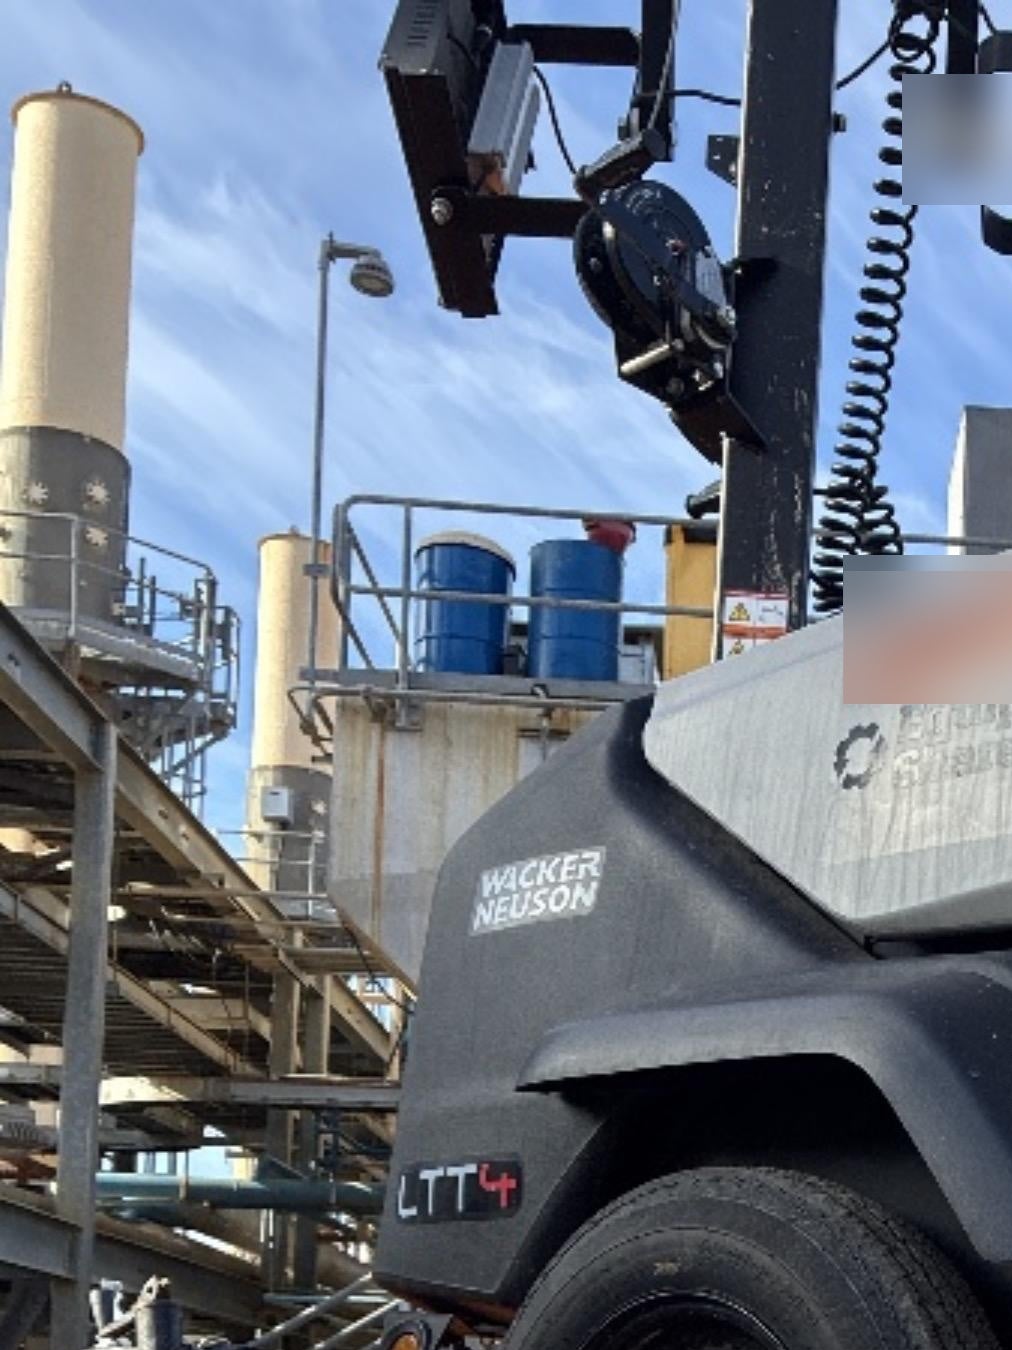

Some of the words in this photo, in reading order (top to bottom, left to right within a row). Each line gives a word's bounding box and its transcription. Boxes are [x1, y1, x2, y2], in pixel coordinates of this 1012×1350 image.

[480, 850, 602, 898] WACKER
[472, 880, 599, 932] NEUSON
[397, 1162, 517, 1219] LTT4
